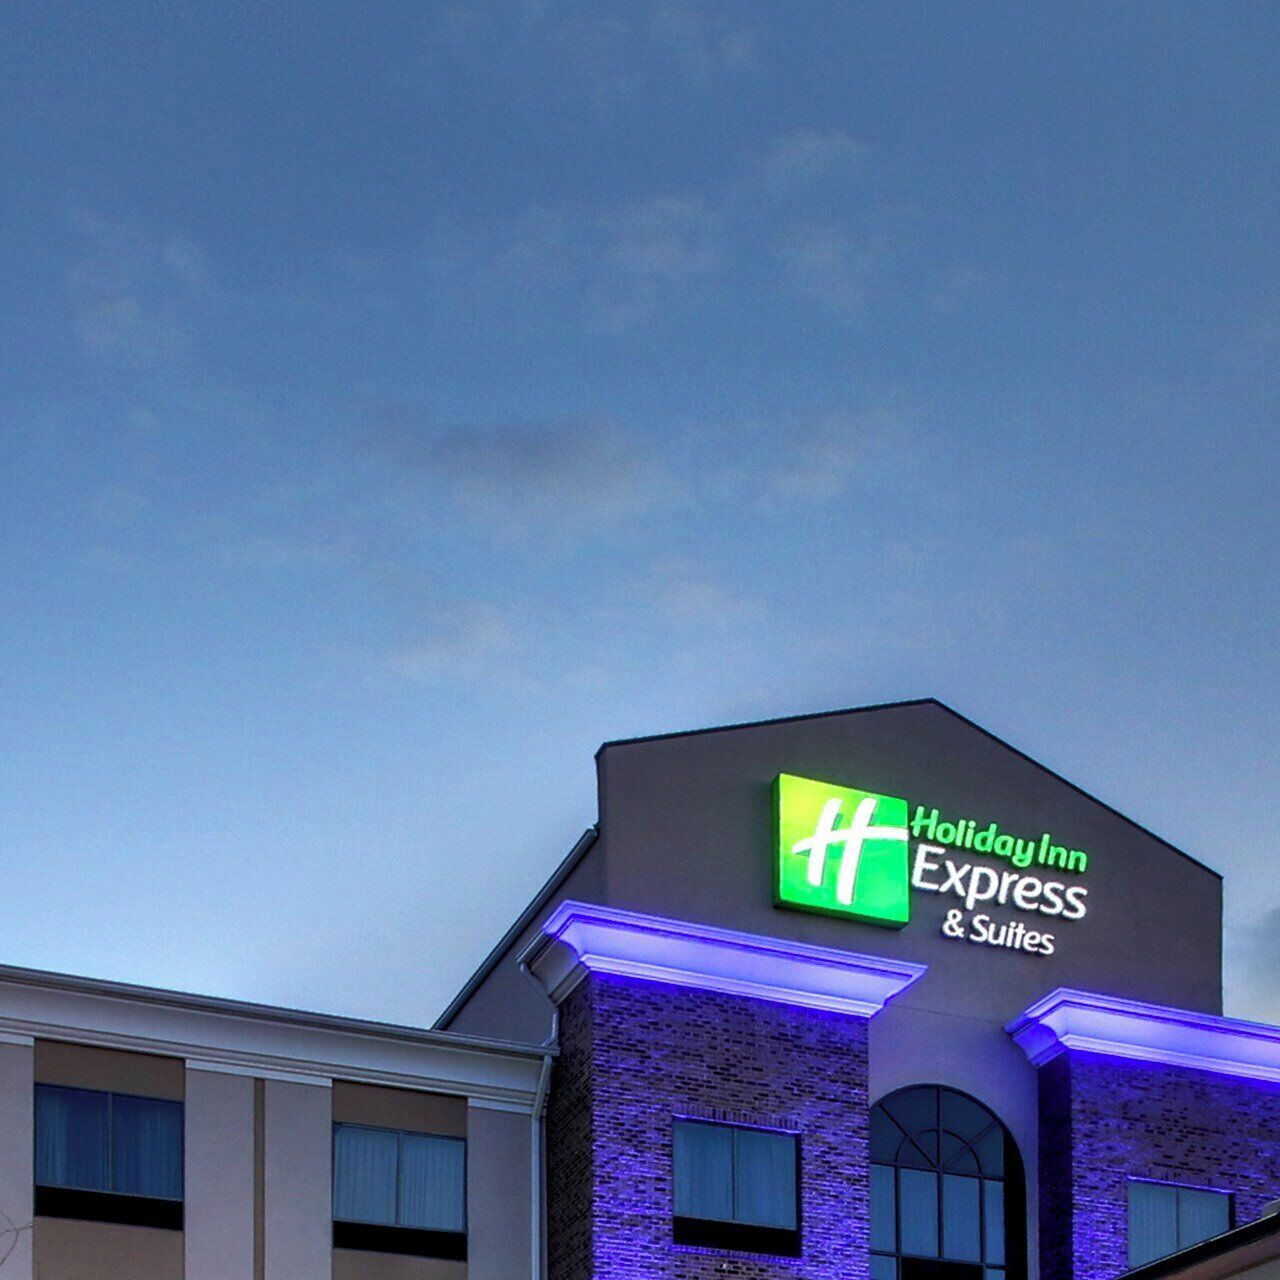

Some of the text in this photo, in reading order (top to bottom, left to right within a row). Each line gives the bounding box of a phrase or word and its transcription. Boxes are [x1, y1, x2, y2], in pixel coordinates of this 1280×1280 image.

[910, 805, 1088, 873] Holiday Inn
[910, 844, 1088, 919] Express
[941, 908, 1056, 955] & Suites
